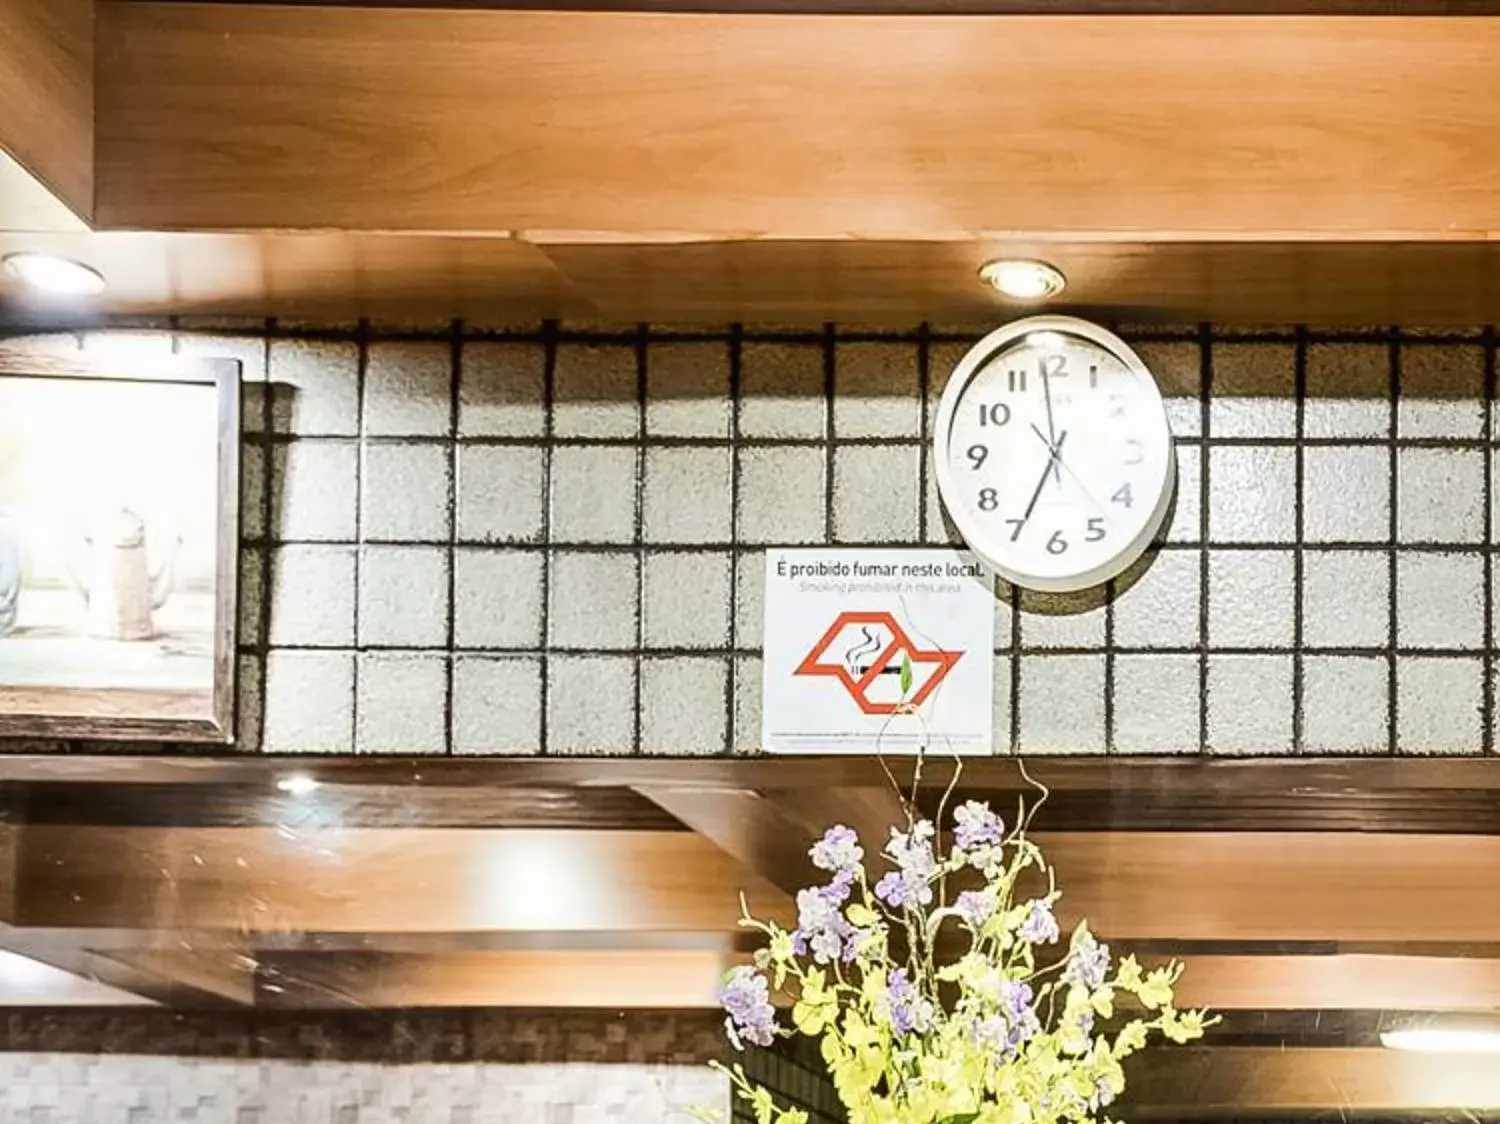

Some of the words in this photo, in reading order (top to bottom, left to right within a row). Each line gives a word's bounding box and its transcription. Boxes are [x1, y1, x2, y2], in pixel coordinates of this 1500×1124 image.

[1008, 370, 1026, 392] 11
[1090, 366, 1098, 389] 1
[979, 403, 1011, 427] 10
[967, 444, 989, 470] 9
[977, 488, 999, 511] 8
[1111, 482, 1134, 508] 4
[1005, 519, 1027, 543] 7
[1085, 518, 1107, 542] 5
[1046, 530, 1068, 555] 6
[777, 556, 787, 576] É
[790, 560, 849, 579] proibido
[853, 560, 898, 577] fumar
[902, 563, 943, 577] neste
